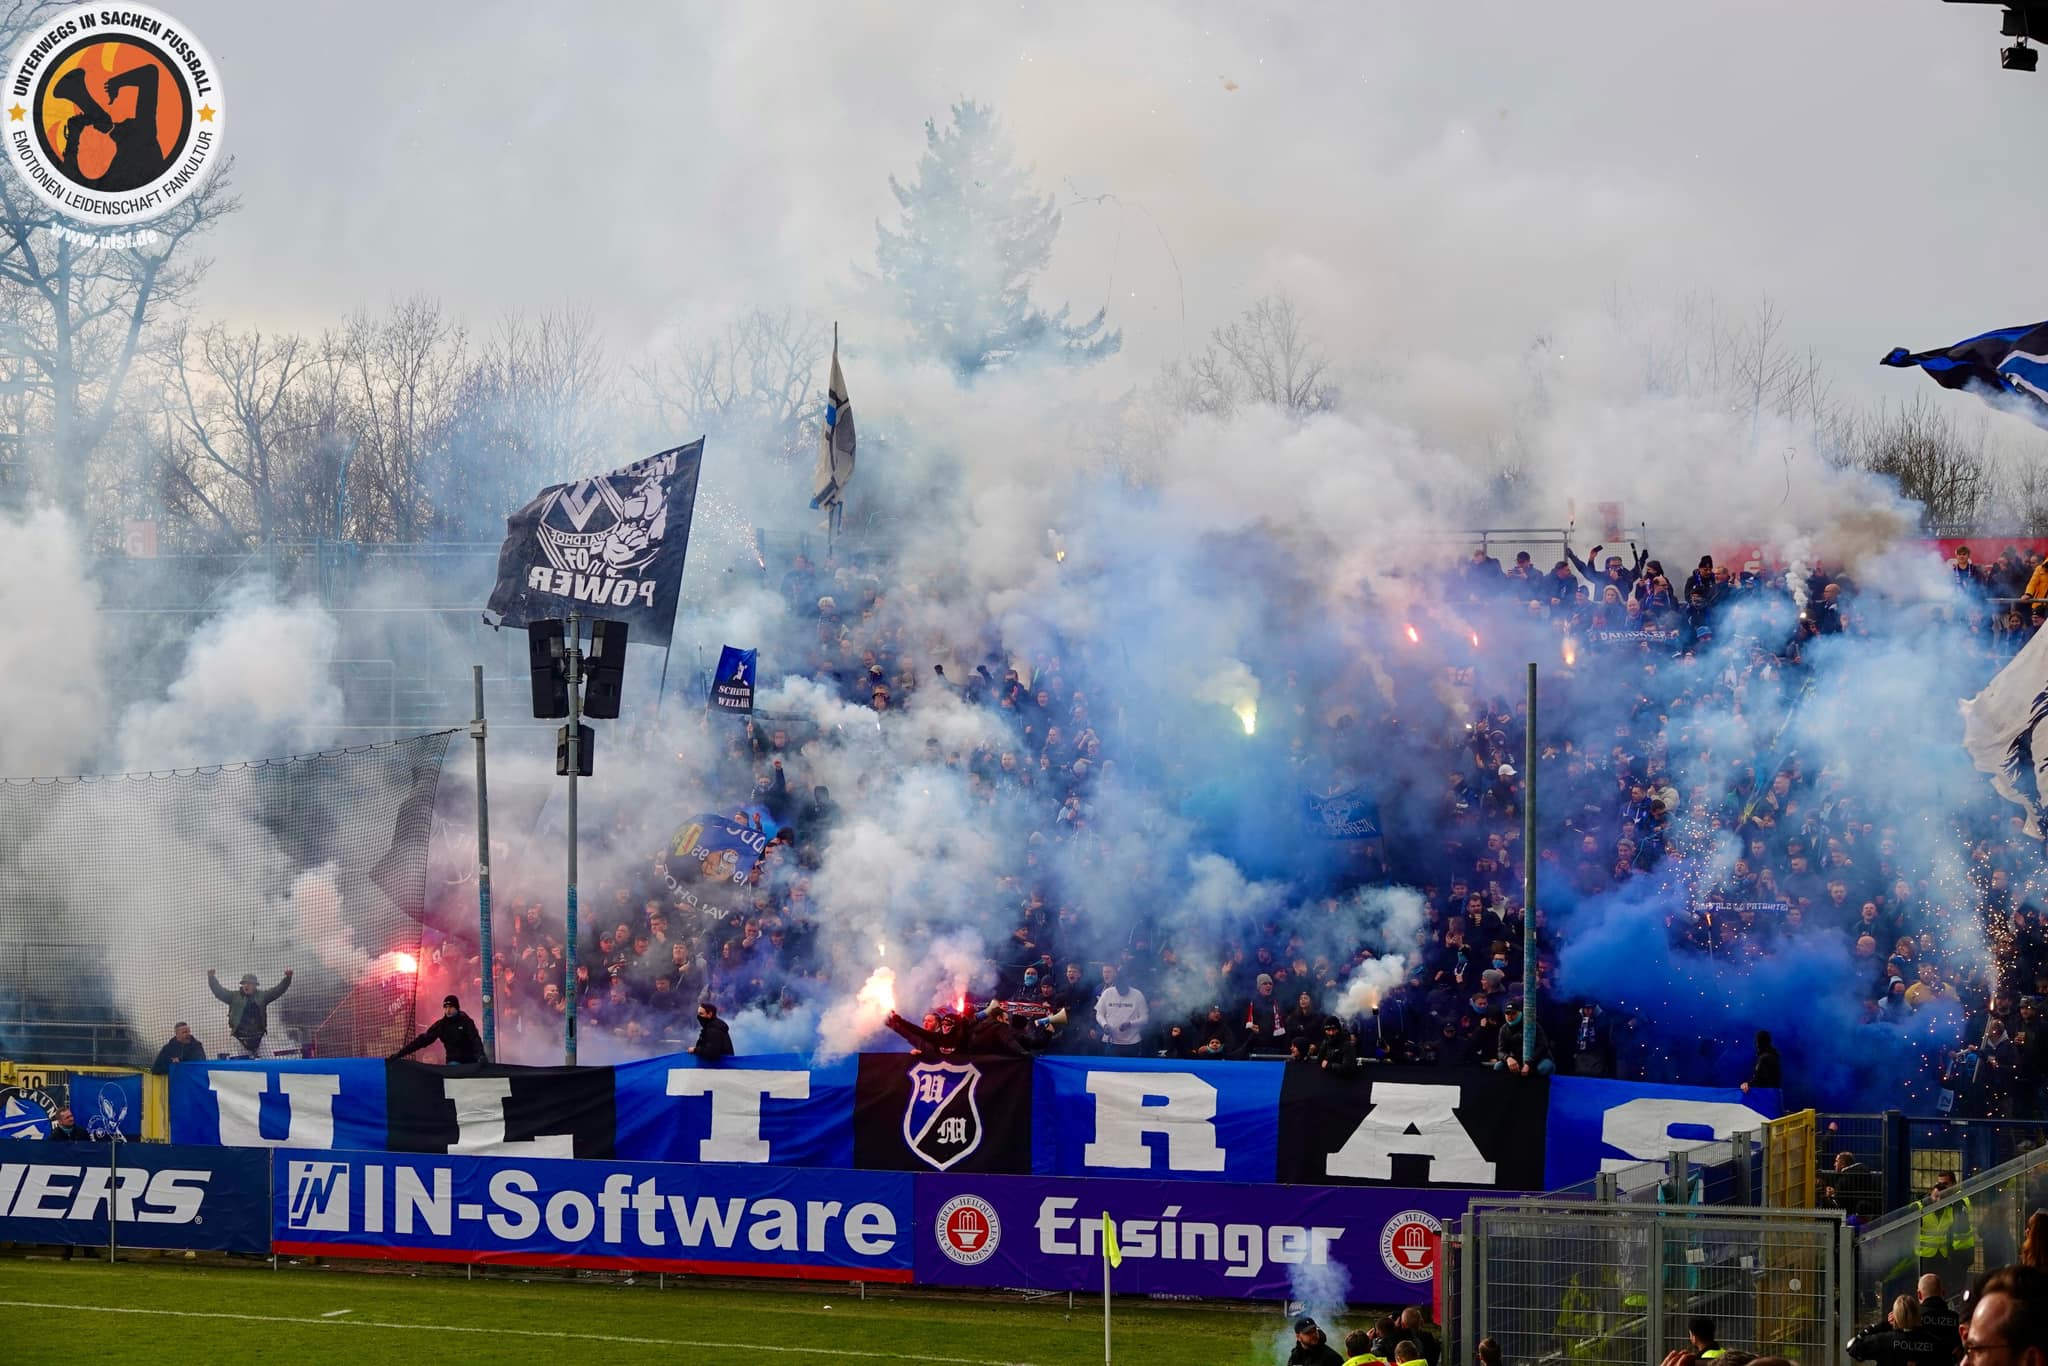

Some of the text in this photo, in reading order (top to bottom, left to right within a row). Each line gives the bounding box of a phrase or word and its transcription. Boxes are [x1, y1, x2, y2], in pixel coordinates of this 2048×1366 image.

[22, 1075, 42, 1088] 10
[364, 1163, 897, 1256] IN-Software
[946, 1246, 990, 1261] ENSINGEN
[1391, 1262, 1433, 1280] ENSINGE
[1893, 1339, 1934, 1353] POLIZEI
